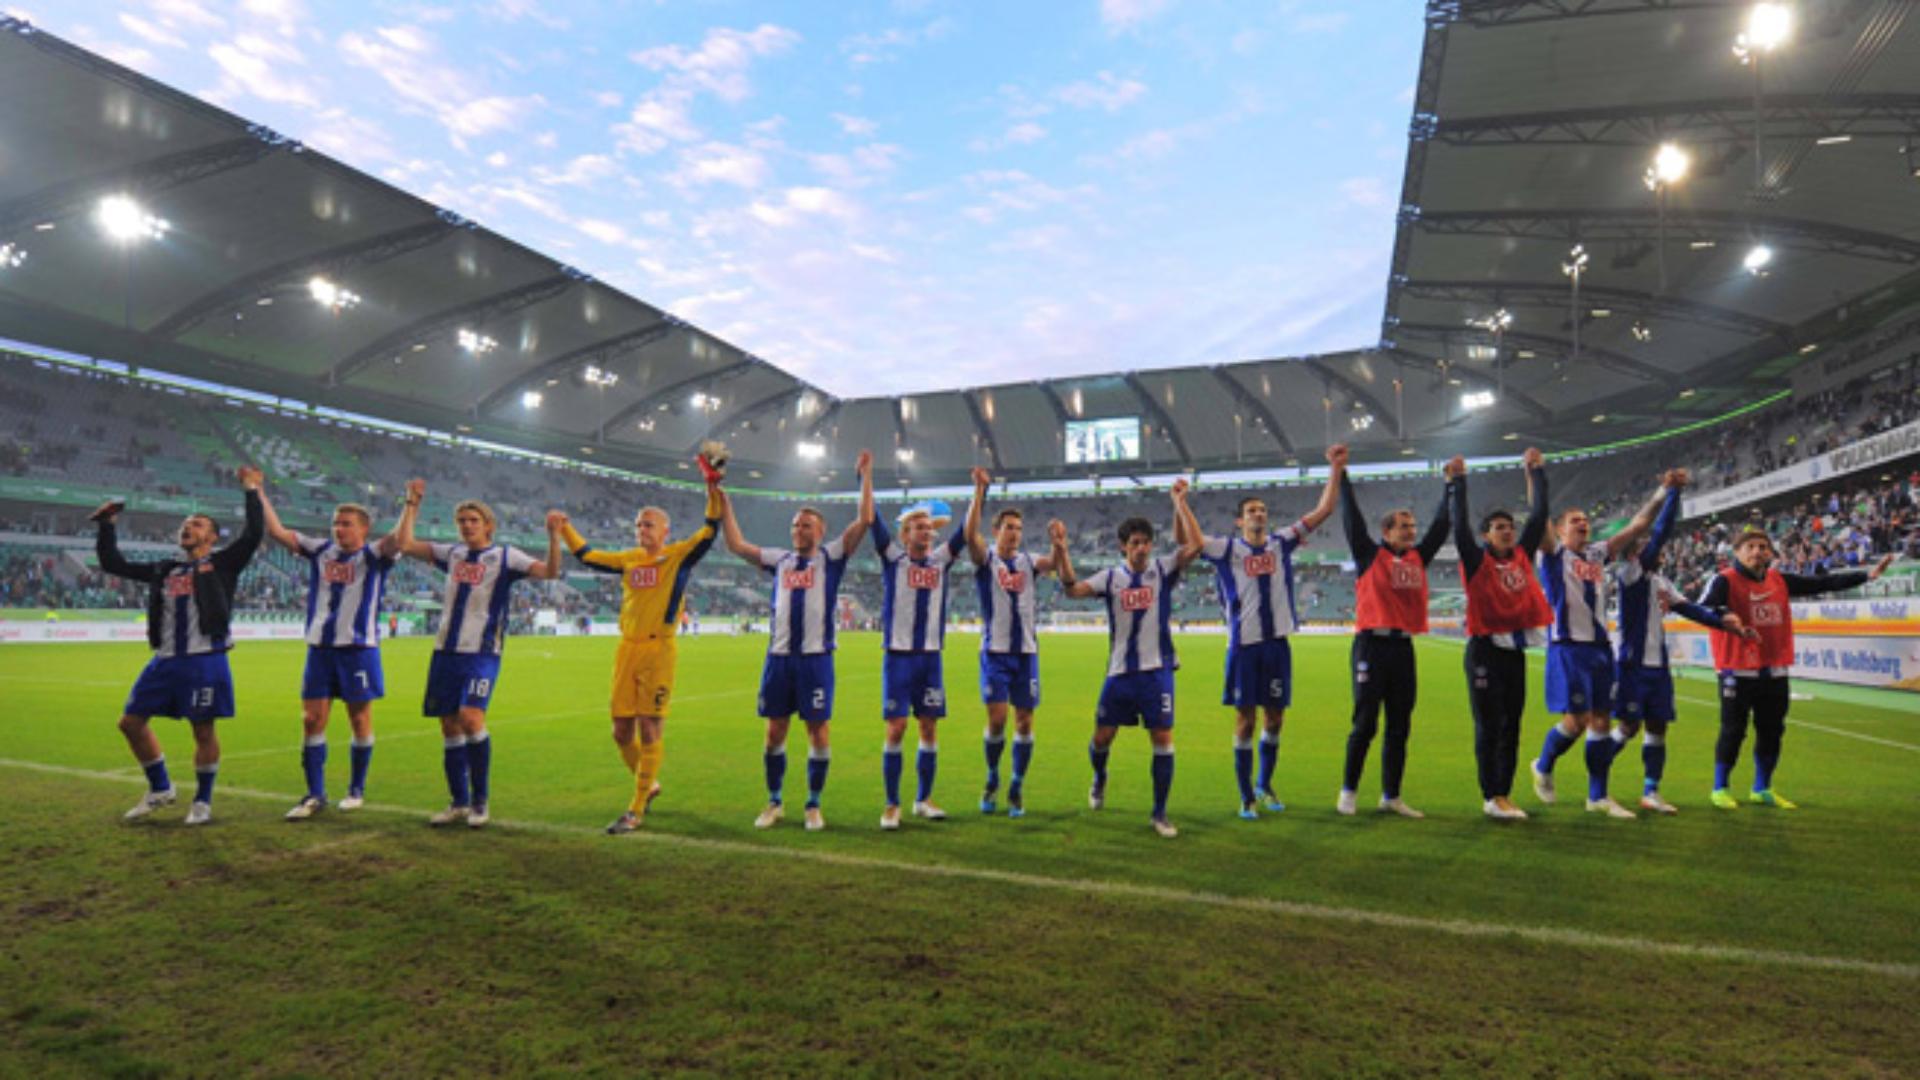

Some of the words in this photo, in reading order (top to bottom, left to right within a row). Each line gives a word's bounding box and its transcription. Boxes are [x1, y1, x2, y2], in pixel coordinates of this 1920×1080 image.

[354, 669, 368, 688] 7
[467, 678, 490, 697] 18
[192, 687, 214, 706] 13
[812, 688, 825, 710] 2
[1160, 693, 1172, 713] 3
